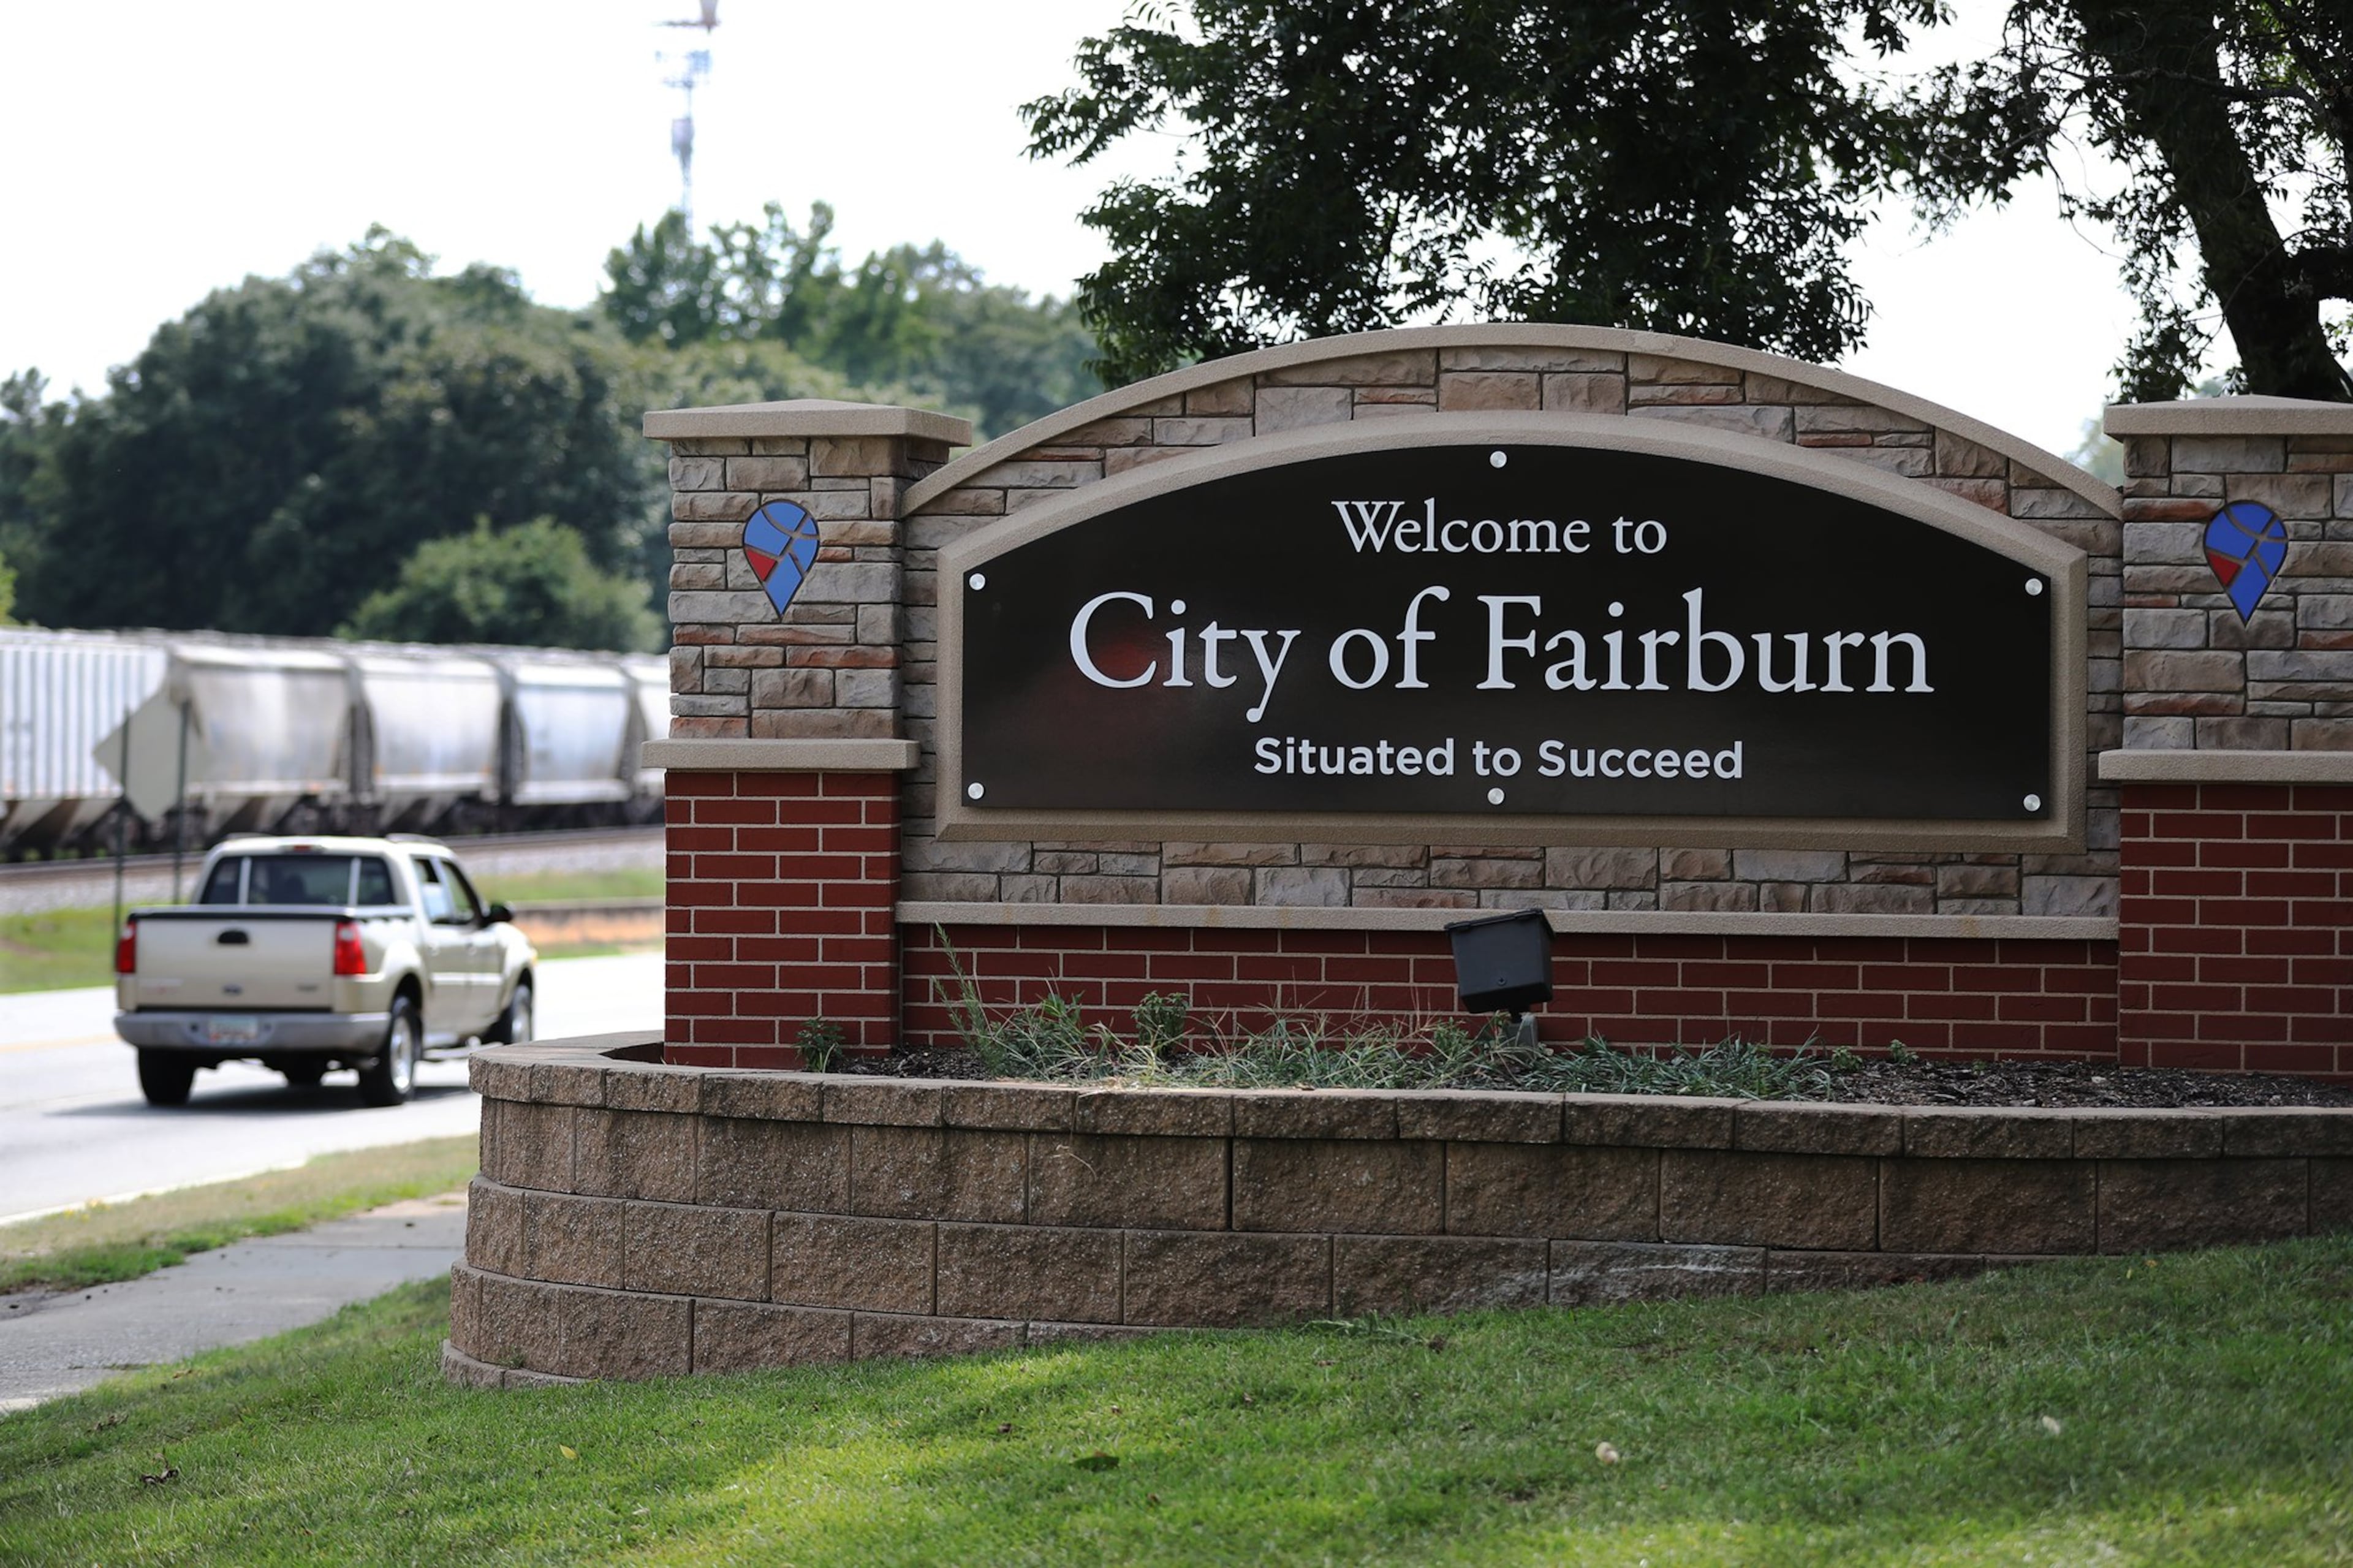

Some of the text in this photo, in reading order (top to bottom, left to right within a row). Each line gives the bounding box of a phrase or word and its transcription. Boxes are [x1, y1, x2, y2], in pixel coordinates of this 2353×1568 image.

[1331, 498, 1667, 554] Welcome to
[1070, 586, 1935, 723] City of Fairburn
[1254, 737, 1743, 779] Situated to Succeed
